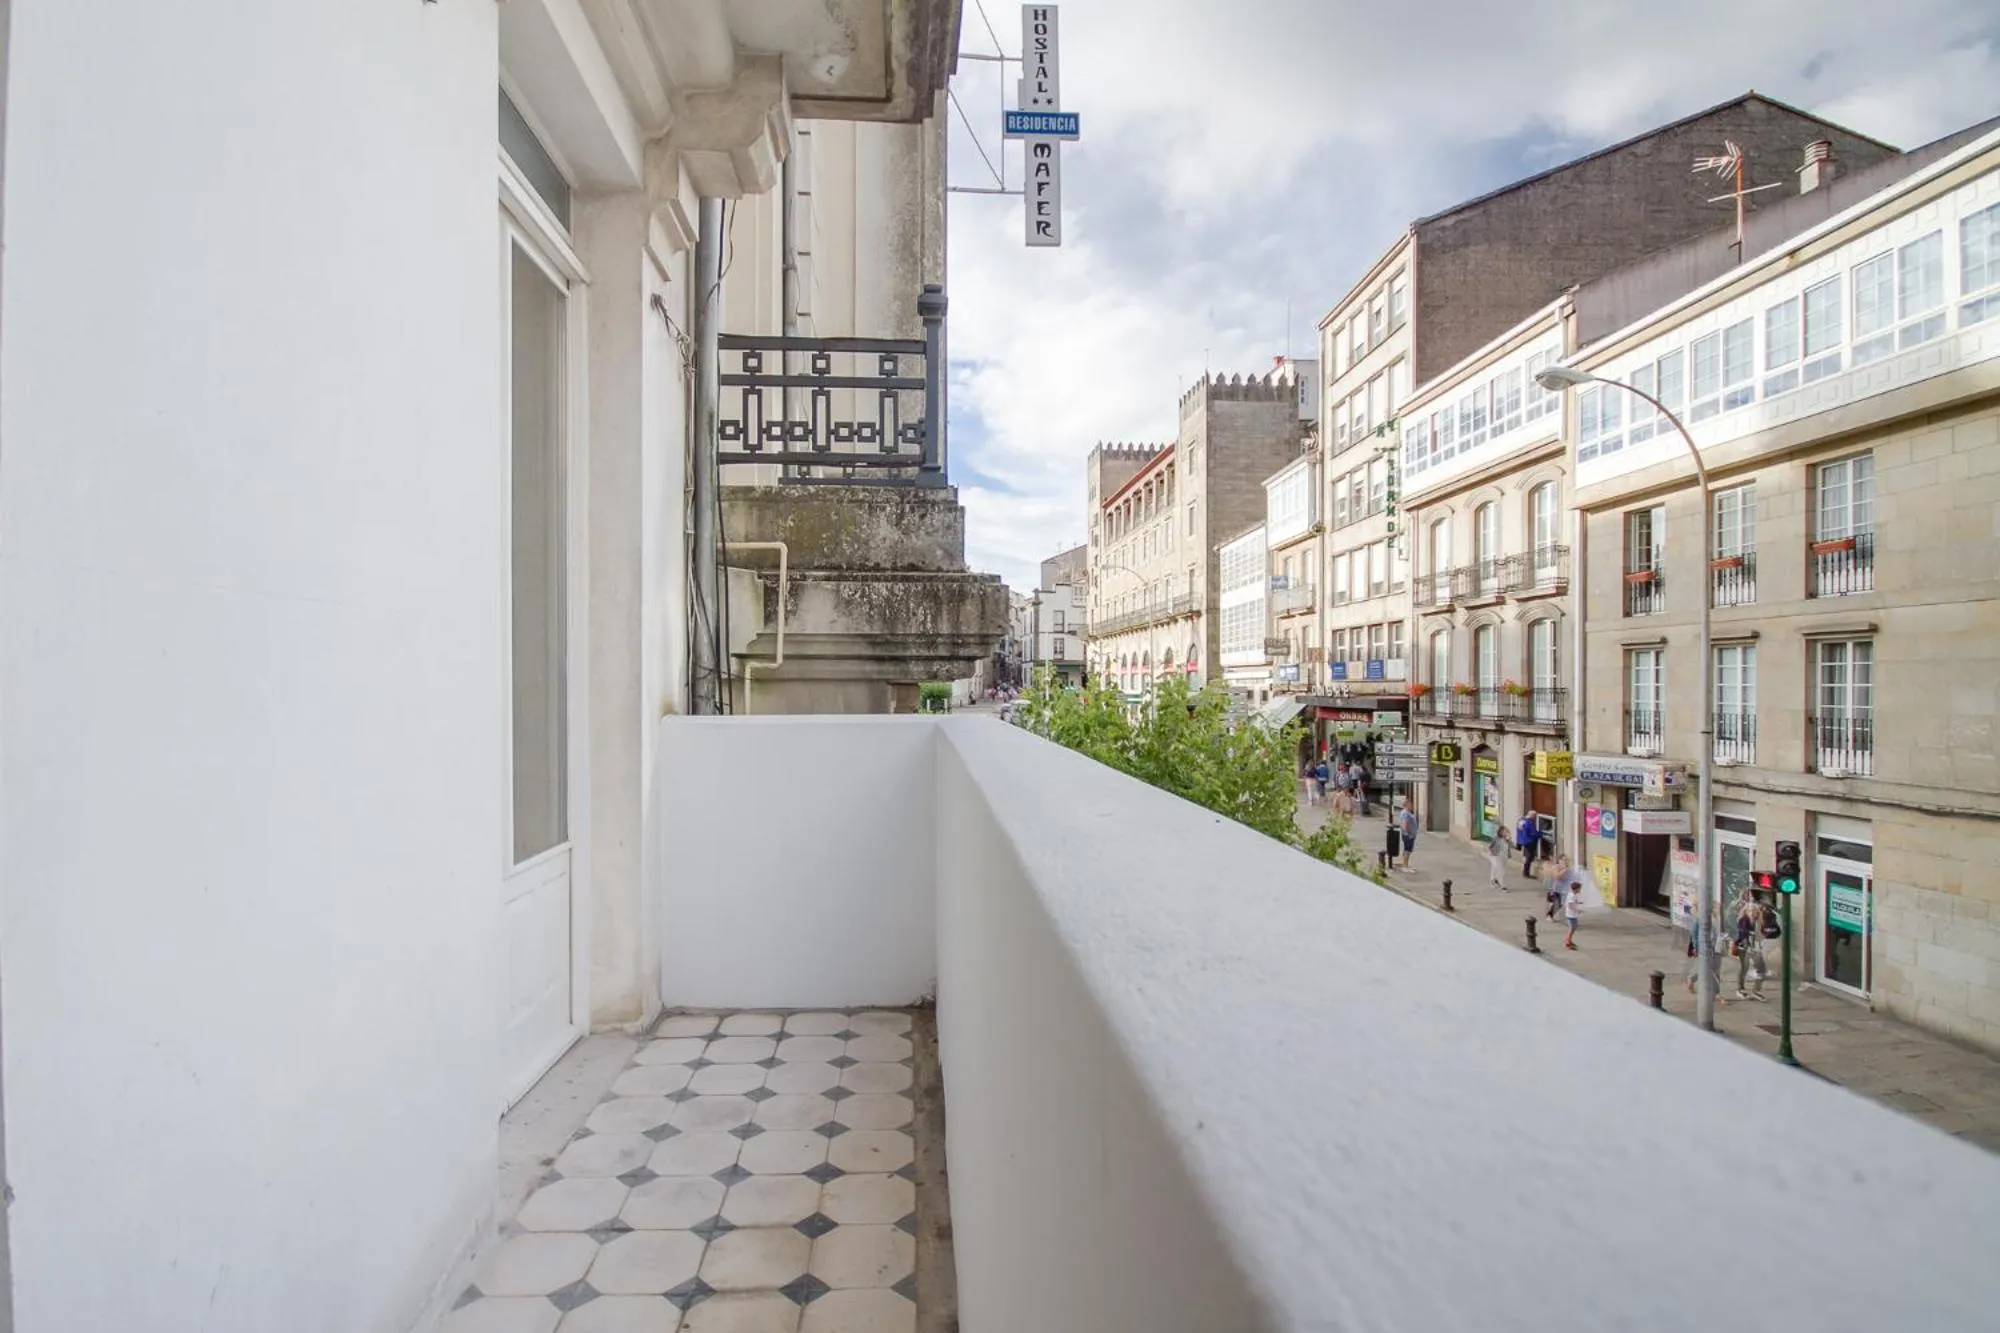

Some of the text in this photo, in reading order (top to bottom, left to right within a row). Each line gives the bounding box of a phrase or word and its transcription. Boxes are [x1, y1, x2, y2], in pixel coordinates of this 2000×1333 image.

[1033, 9, 1048, 93] HOSTAL
[1007, 114, 1077, 131] RESIDENCIA
[1033, 143, 1054, 238] MAFER
